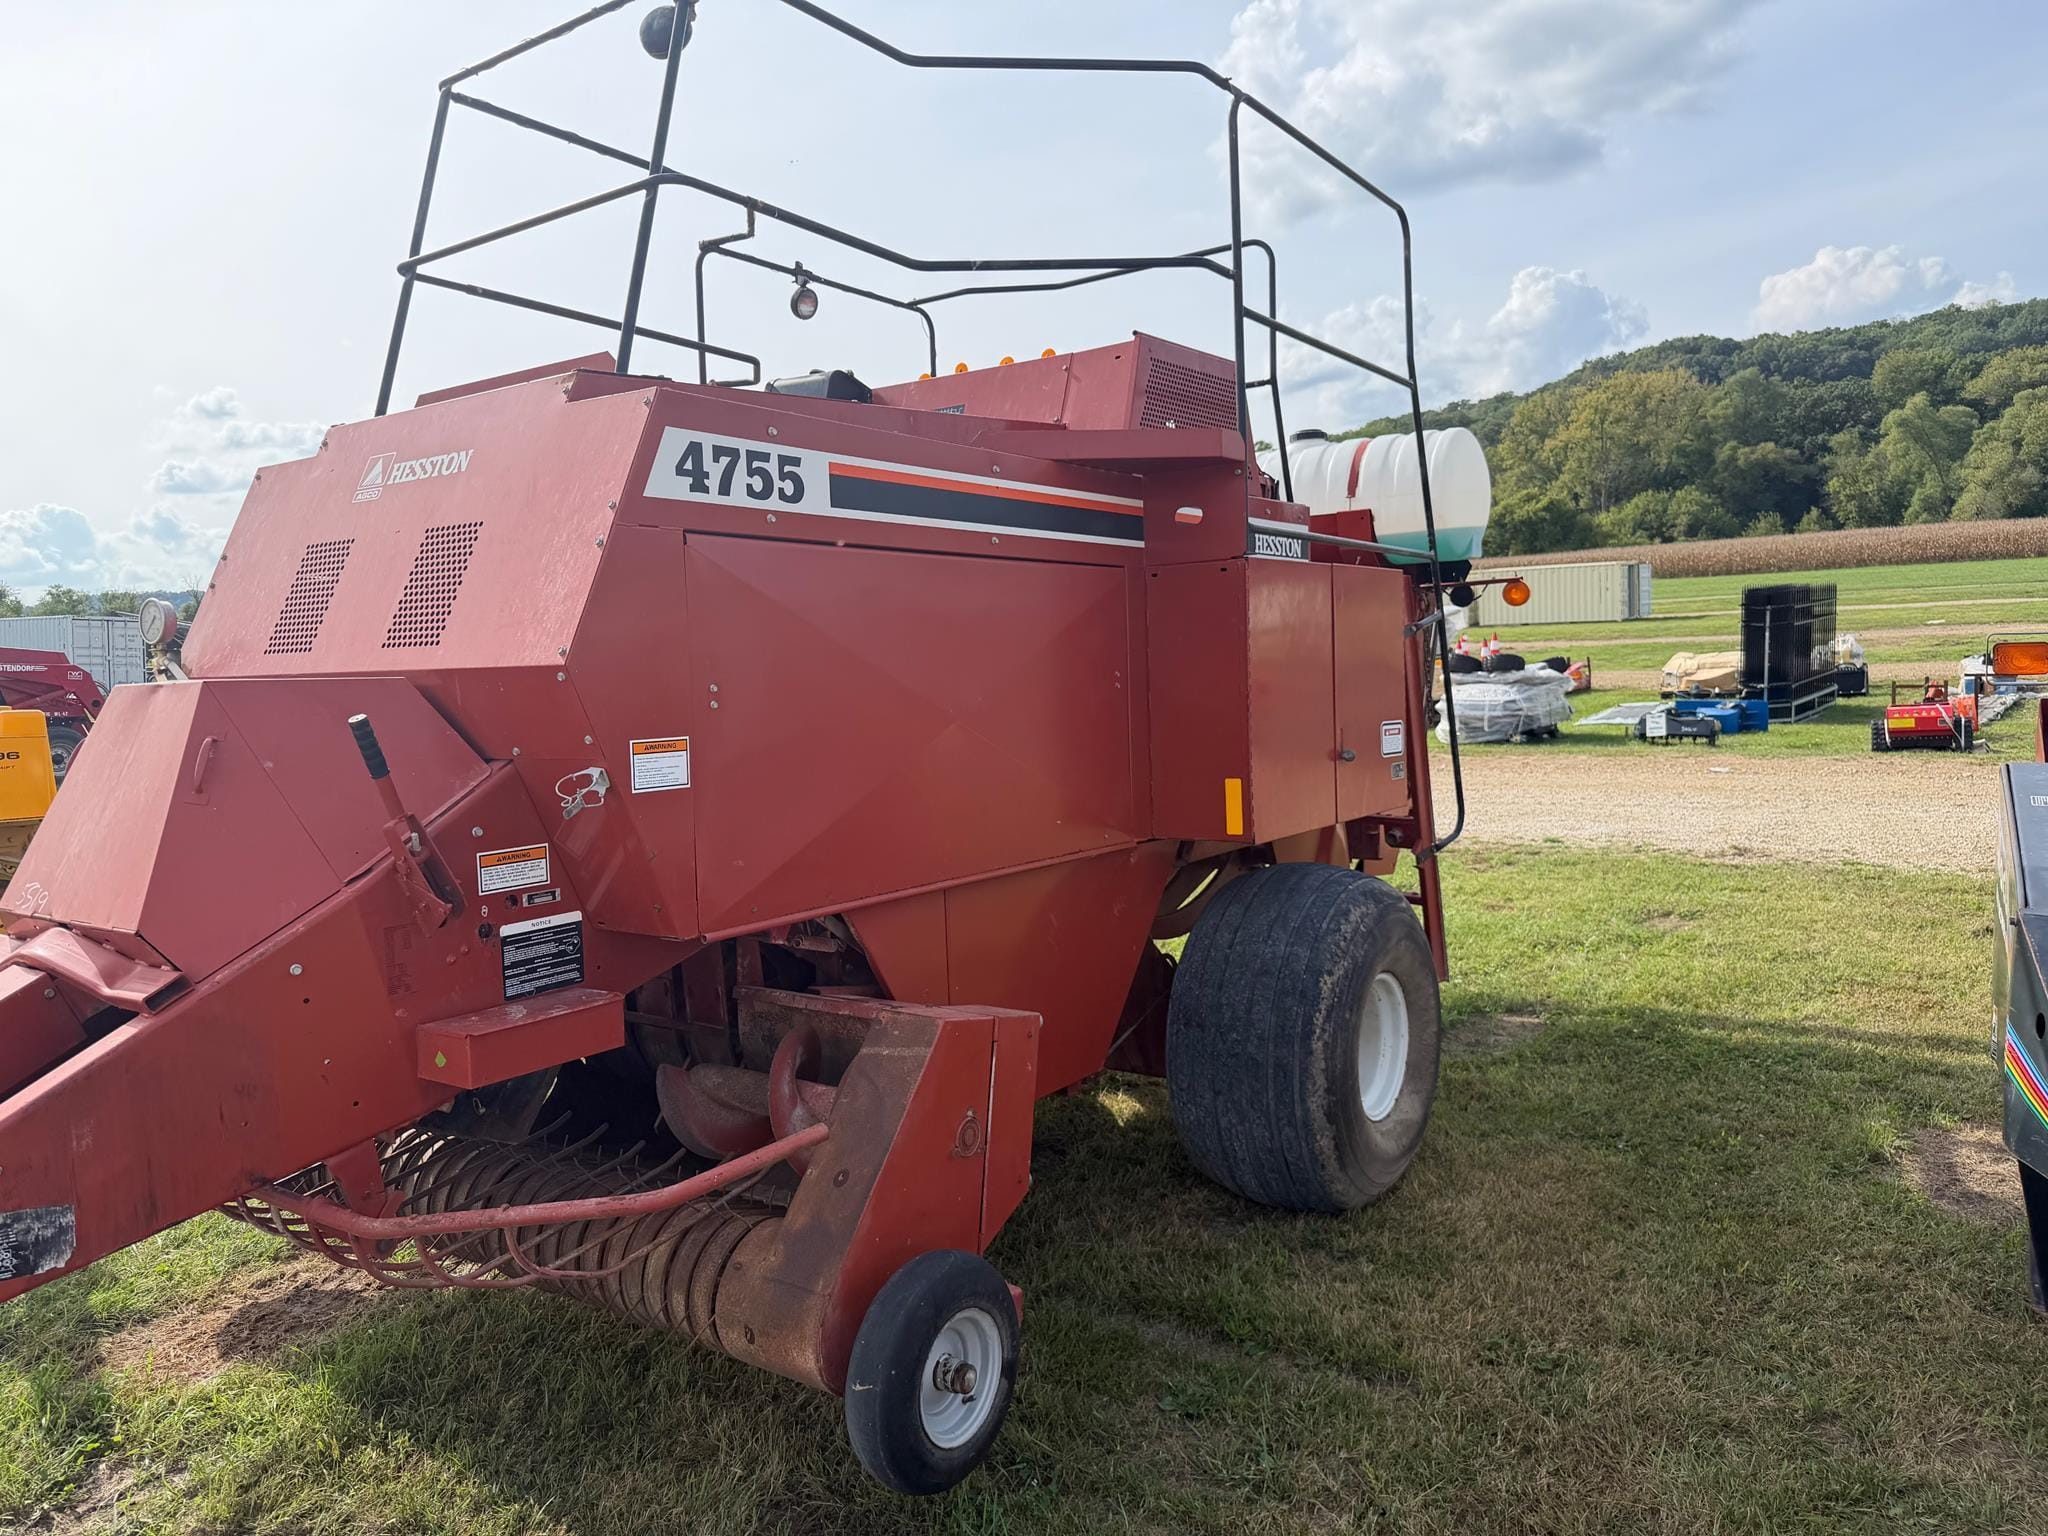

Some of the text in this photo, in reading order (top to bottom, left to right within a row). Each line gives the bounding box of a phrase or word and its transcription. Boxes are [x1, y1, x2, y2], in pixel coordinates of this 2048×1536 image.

[387, 448, 474, 485] HESSTON
[675, 440, 805, 504] 4755
[355, 490, 379, 500] AGCO
[1254, 533, 1302, 558] HESSTON
[649, 742, 677, 751] WARNING
[501, 852, 531, 862] WARNING
[531, 919, 551, 928] NOTICE
